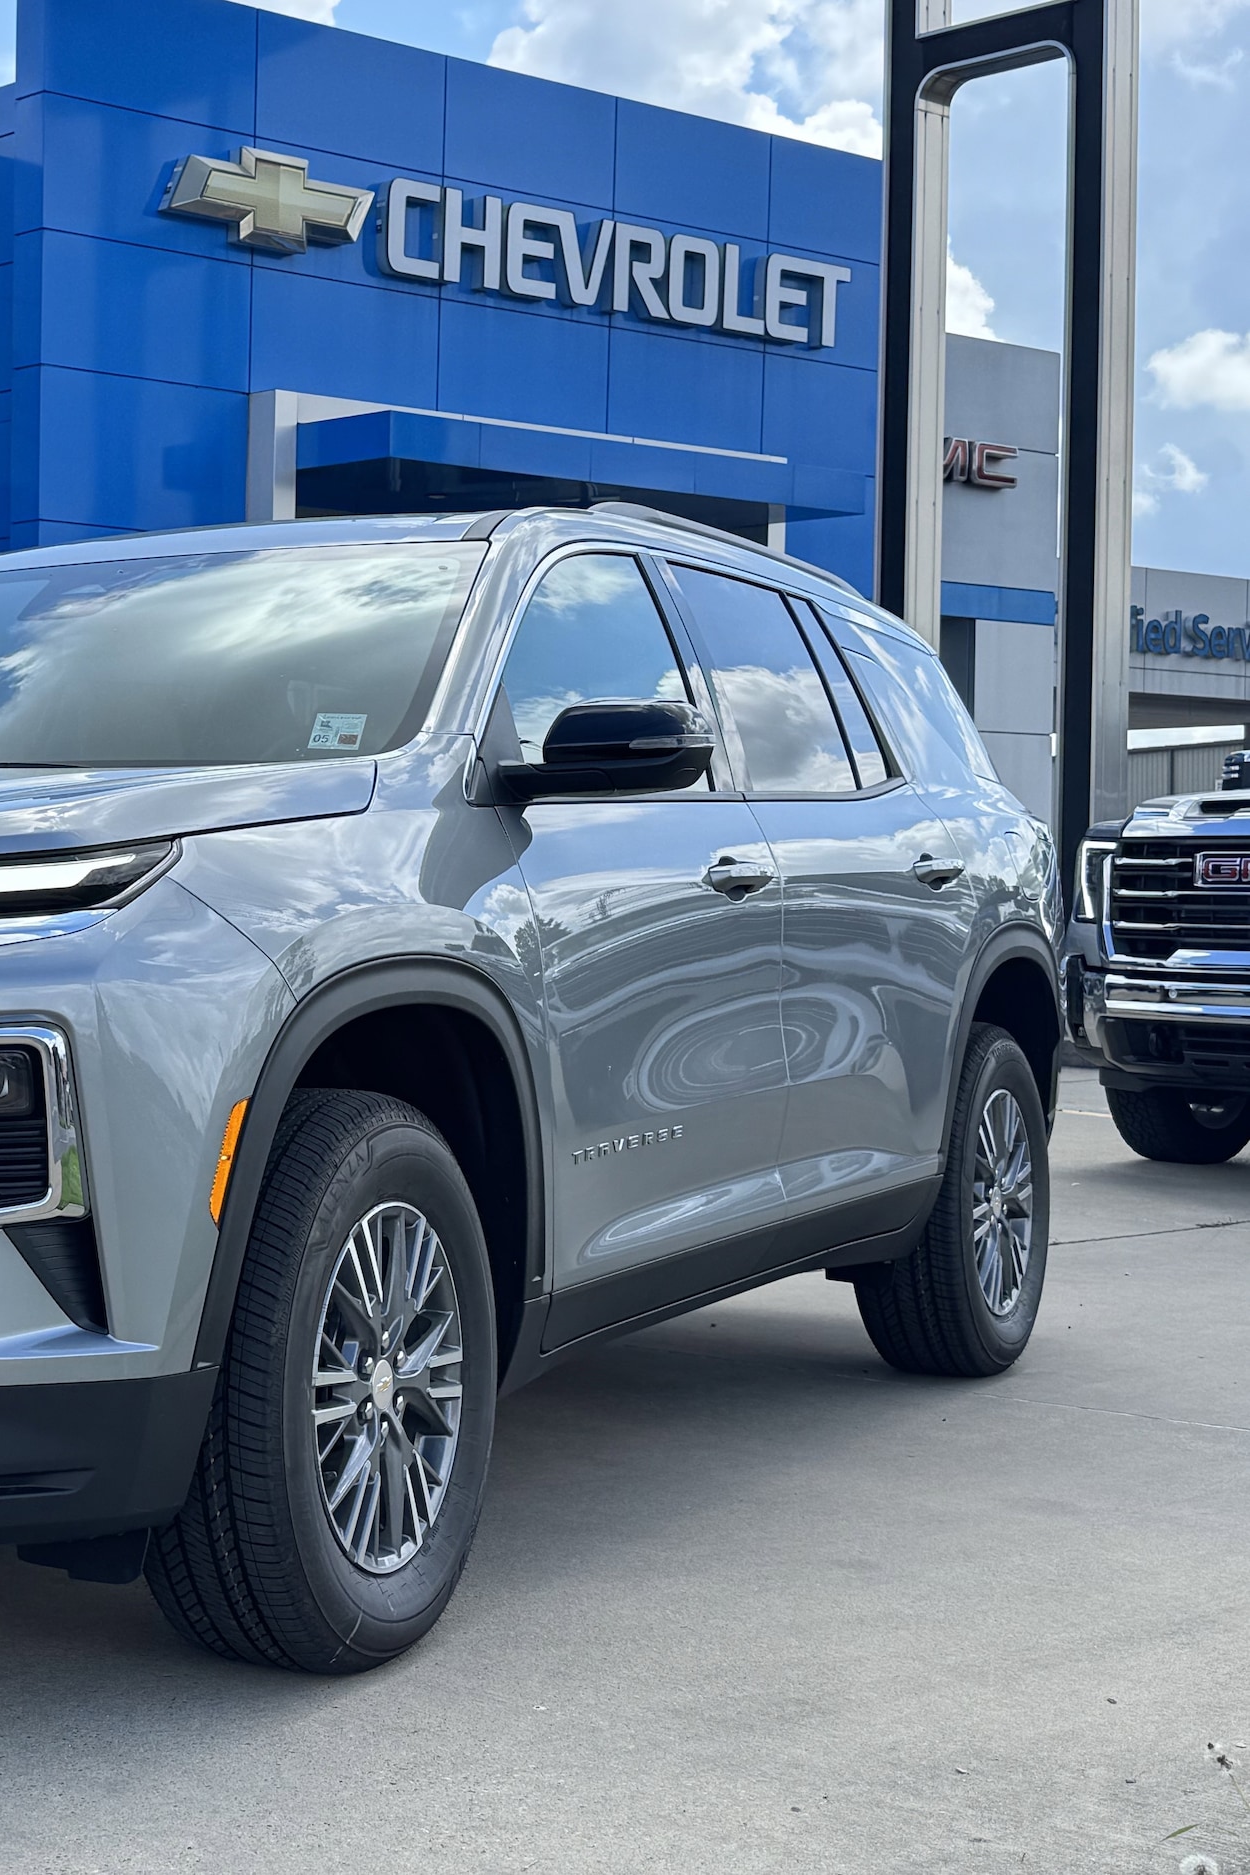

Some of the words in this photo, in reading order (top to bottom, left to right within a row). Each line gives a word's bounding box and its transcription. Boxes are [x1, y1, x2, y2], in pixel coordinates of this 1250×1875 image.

[380, 177, 851, 348] CHEVROLET
[1130, 605, 1182, 655] ied
[1202, 857, 1250, 882] G
[571, 1124, 684, 1166] TRAVERSE
